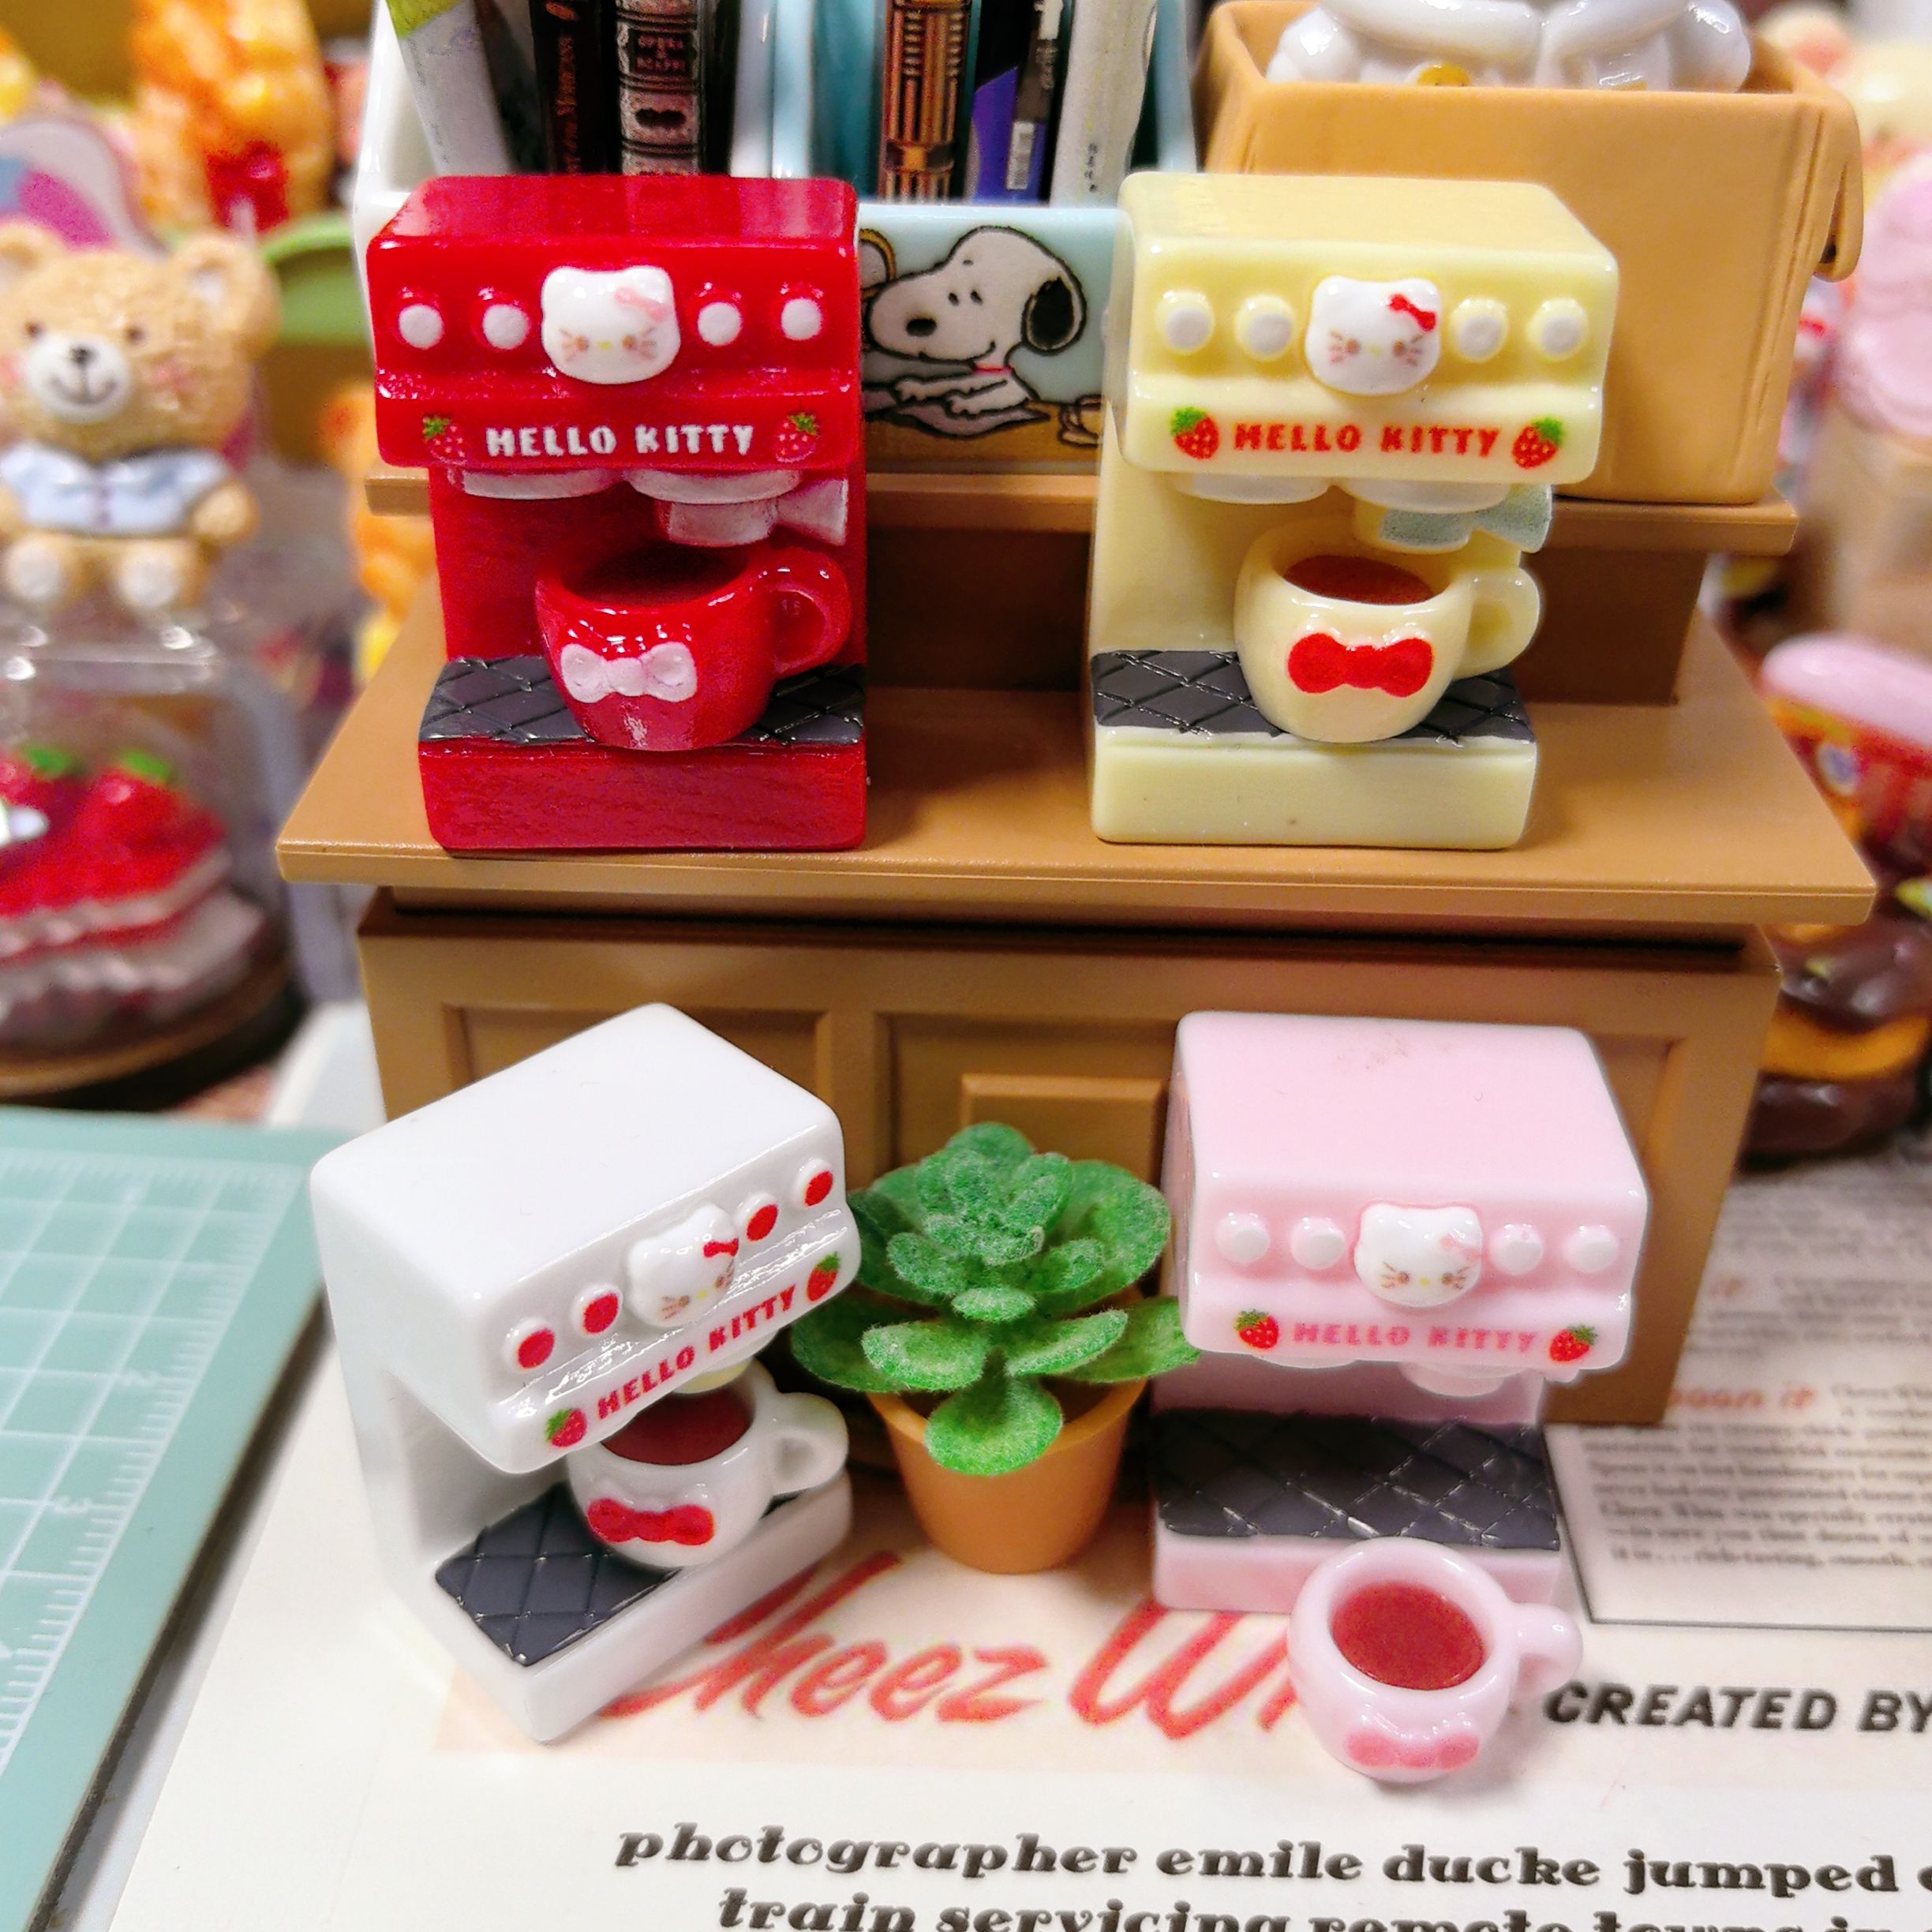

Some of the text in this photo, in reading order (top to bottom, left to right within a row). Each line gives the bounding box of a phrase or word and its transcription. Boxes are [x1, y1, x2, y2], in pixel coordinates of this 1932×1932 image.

[485, 424, 754, 457] HELLO KITTY
[1233, 422, 1500, 458] HELLO KITTY
[596, 1284, 797, 1421] HELLO KITTY
[1292, 1322, 1537, 1354] HELLO KITTY
[1543, 1680, 1932, 1733] CREATED BY
[615, 1822, 1137, 1878] photographer
[1156, 1839, 1362, 1880] emile
[1383, 1844, 1600, 1885] ducke
[1623, 1848, 1900, 1898] jumped
[719, 1887, 915, 1932] train
